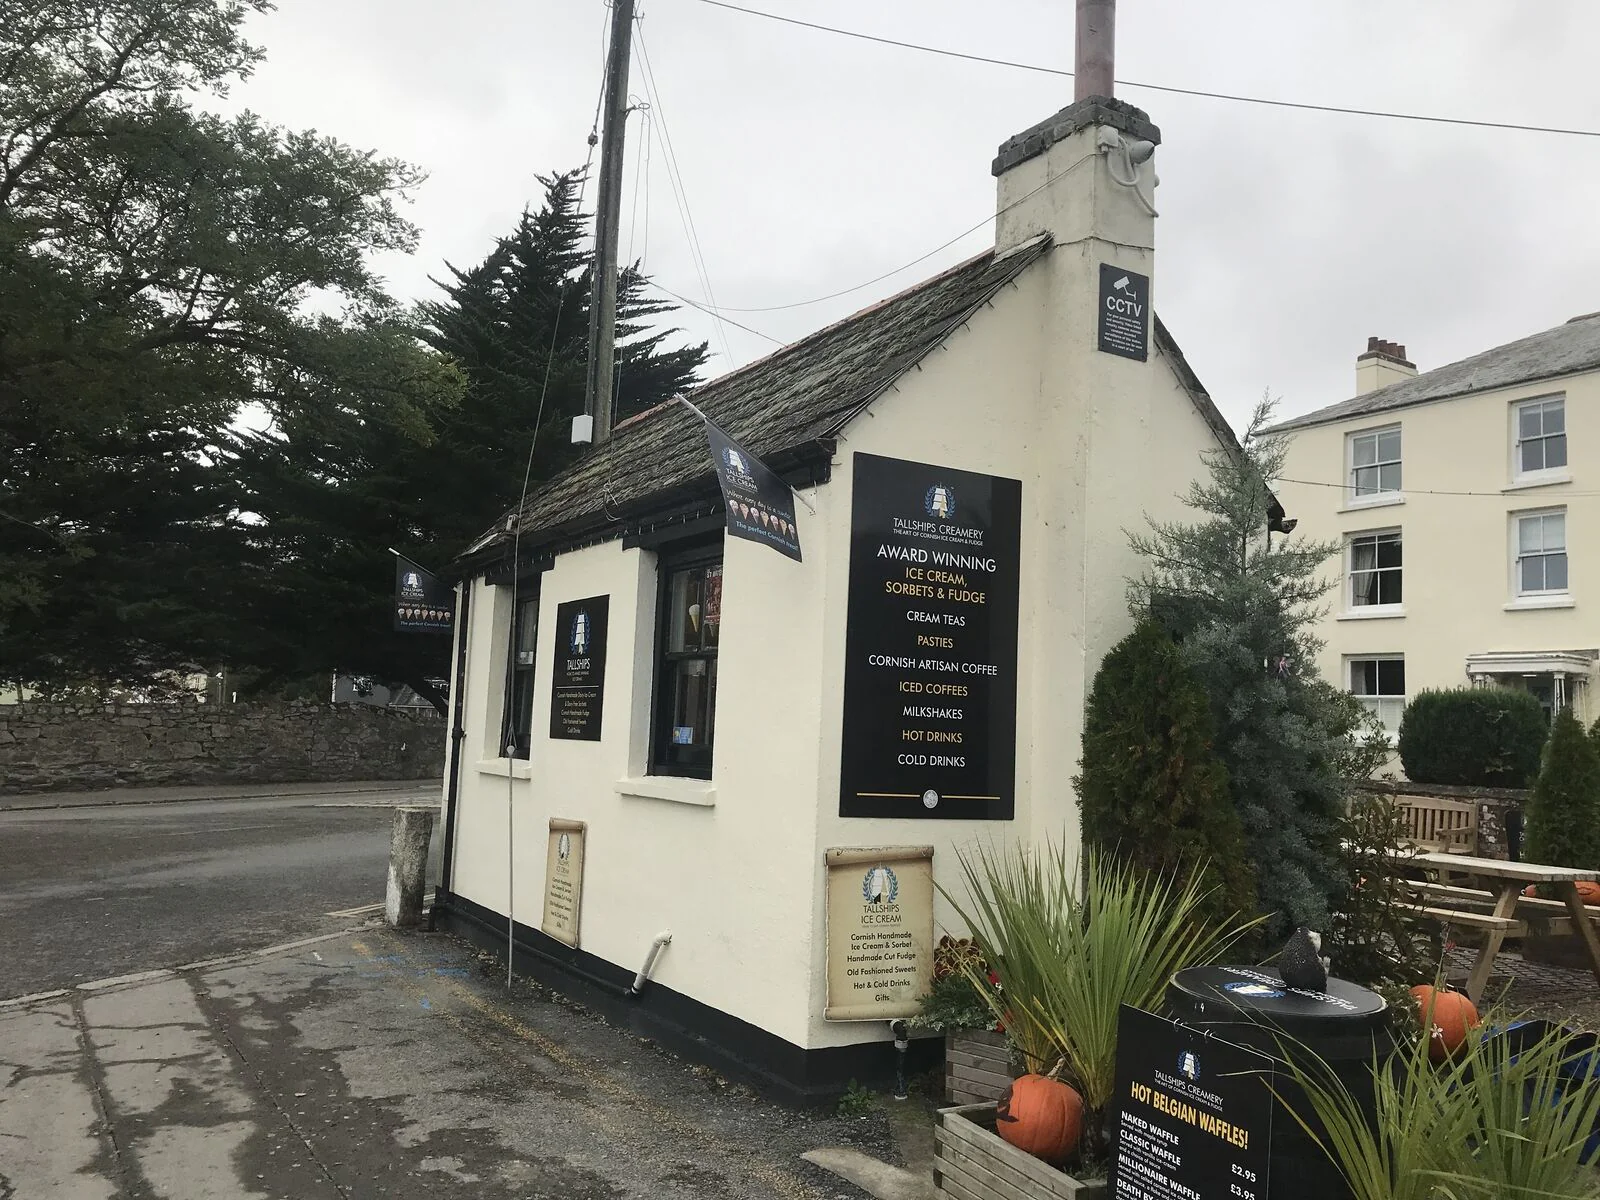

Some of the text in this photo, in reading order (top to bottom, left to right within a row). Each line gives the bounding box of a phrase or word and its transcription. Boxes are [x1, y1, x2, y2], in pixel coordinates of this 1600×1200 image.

[1106, 296, 1142, 317] CCTV
[726, 468, 754, 483] TALLSHIPS
[726, 475, 738, 483] ICE
[738, 479, 758, 490] CREAM
[736, 521, 747, 529] The
[747, 526, 767, 536] perfect
[768, 532, 785, 545] Cornish
[893, 517, 984, 539] TALLSHIPS CREAMERY
[920, 532, 940, 540] CORNISH
[877, 544, 997, 572] AWARD WINNING
[905, 567, 968, 587] ICE CREAM,
[885, 581, 985, 604] SORBETS & FUDGE
[906, 610, 966, 626] CREAM TEAS
[918, 635, 953, 649] PASTIES
[566, 658, 590, 670] TALLSHIPS
[868, 654, 998, 676] CORNISH ARTISAN COFFEE
[899, 681, 968, 697] ICED COFFEES
[903, 705, 963, 720] MILKSHAKES
[902, 729, 962, 744] HOT DRINKS
[897, 754, 966, 768] COLD DRINKS
[863, 903, 900, 913] TALLSHIPS
[861, 914, 902, 924] ICE CREAM
[851, 931, 912, 941] Cornish Handmade
[851, 943, 860, 951] Ice
[862, 942, 884, 950] Cream
[891, 941, 912, 949] Sorbet
[847, 952, 916, 963] Handmade Cut Fudge
[847, 966, 917, 976] Old Fashioned Sweets
[853, 979, 910, 990] Hot & Cold Drinks
[874, 994, 890, 1002] Gifts
[1155, 1070, 1223, 1105] TALLSHIPS CREAMERY
[1131, 1081, 1249, 1150] HOT BELGIAN WAFFLES!
[1120, 1120, 1134, 1131] Served
[1134, 1127, 1143, 1135] with
[1121, 1110, 1179, 1146] NAKED WAFFLE
[1120, 1138, 1133, 1148] Served
[1133, 1145, 1142, 1153] with
[1120, 1129, 1181, 1166] CLASSIC WAFFLE
[1118, 1162, 1132, 1173] Served
[1231, 1163, 1256, 1183] £2.95
[1118, 1153, 1201, 1200] MILLIONAIRE WAFFLE
[1117, 1178, 1154, 1200] DEATH BY
[1230, 1183, 1255, 1200] £3.95
